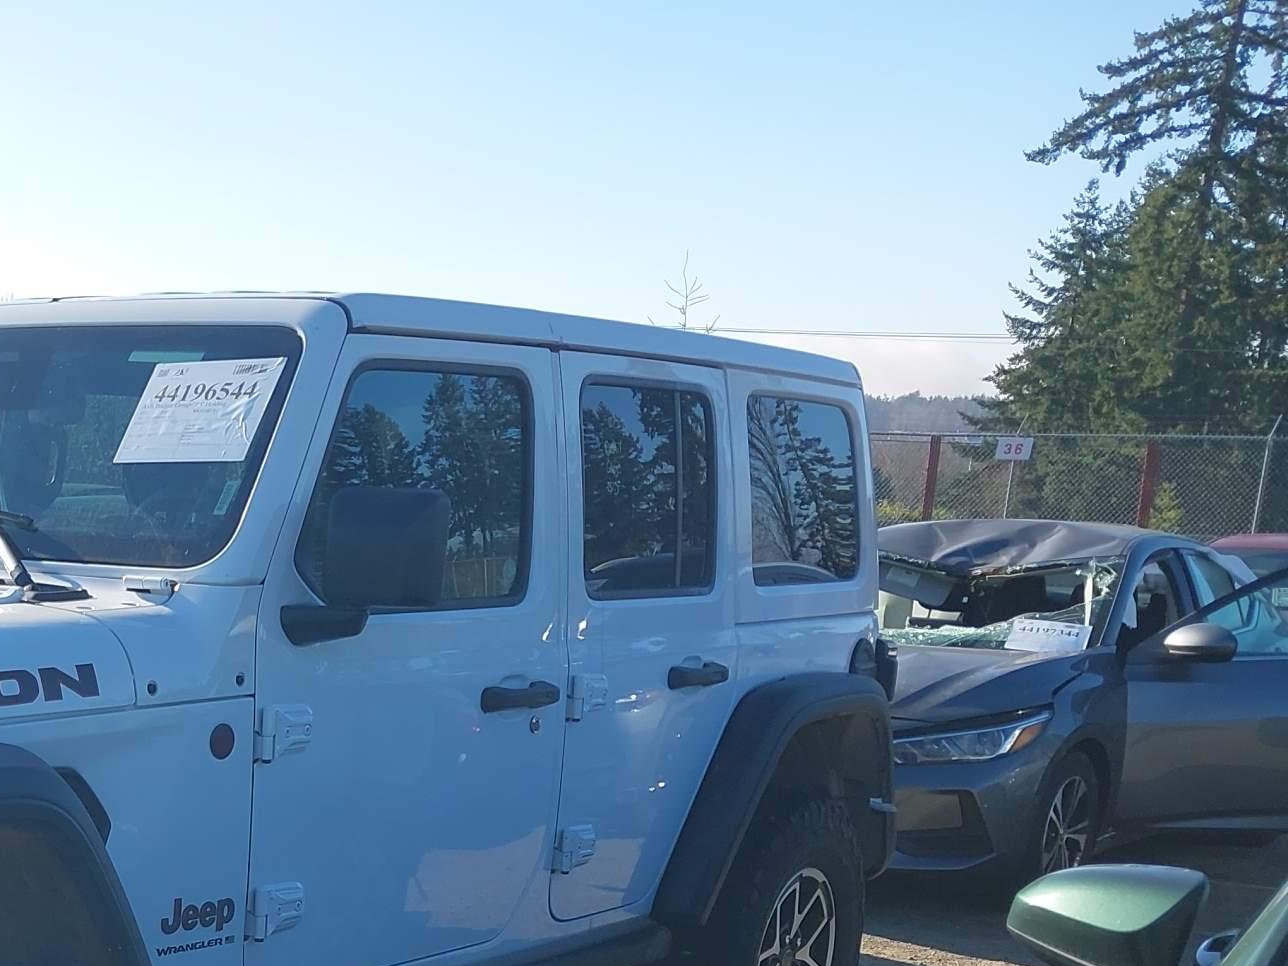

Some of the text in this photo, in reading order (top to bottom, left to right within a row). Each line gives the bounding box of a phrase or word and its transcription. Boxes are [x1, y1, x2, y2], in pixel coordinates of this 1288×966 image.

[154, 380, 260, 403] 44196544
[1003, 443, 1024, 455] 36
[161, 897, 236, 935] Jeep
[156, 937, 223, 957] WRANGLER
